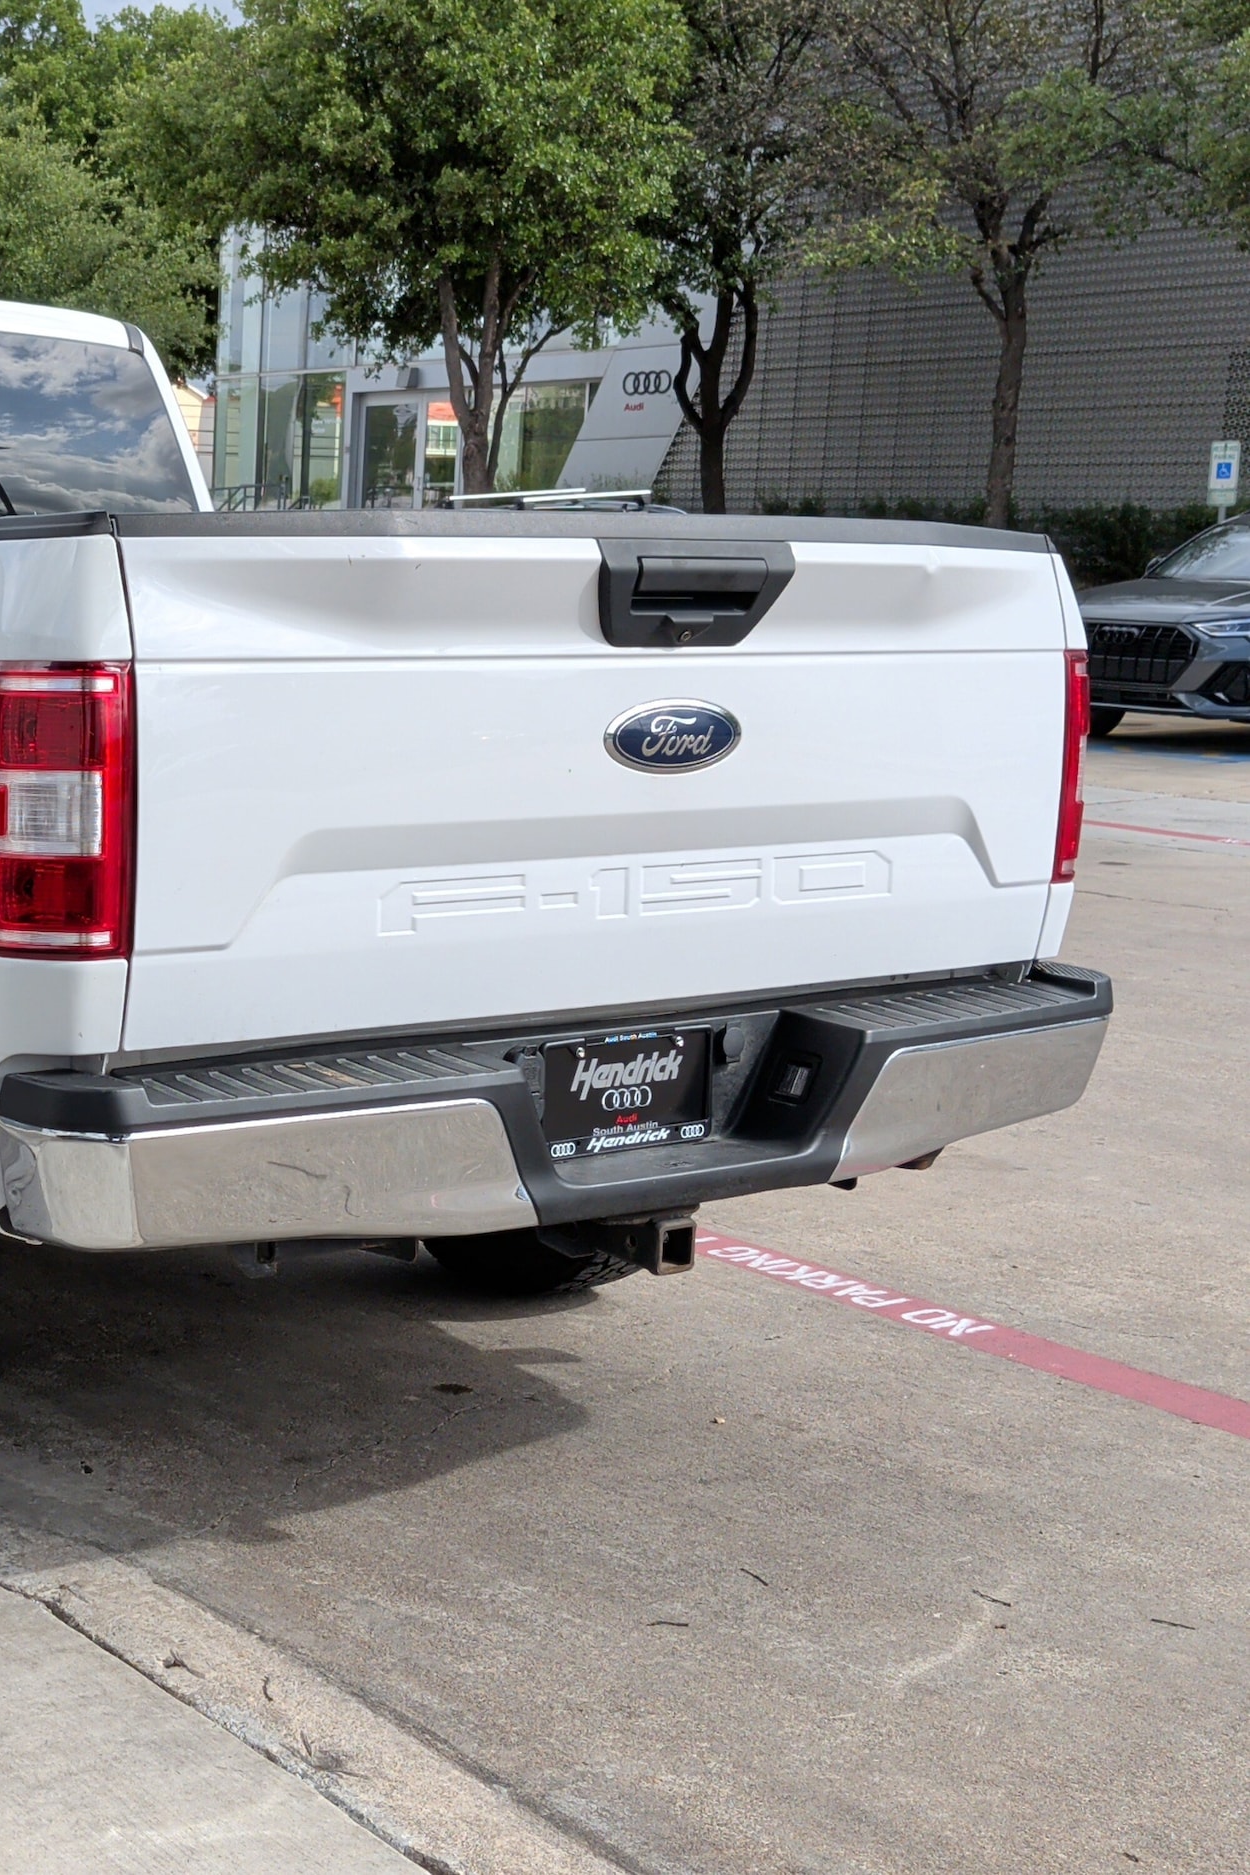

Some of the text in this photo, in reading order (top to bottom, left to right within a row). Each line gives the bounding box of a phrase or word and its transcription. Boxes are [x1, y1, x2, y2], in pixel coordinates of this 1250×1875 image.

[624, 402, 644, 411] Audi
[641, 715, 715, 757] Ford
[377, 849, 893, 937] F-150
[570, 1050, 683, 1101] Hendrick
[592, 1120, 659, 1137] South Austin
[616, 1113, 638, 1124] Audi
[586, 1127, 670, 1153] Hendrick
[707, 1246, 996, 1336] NO PARKING
